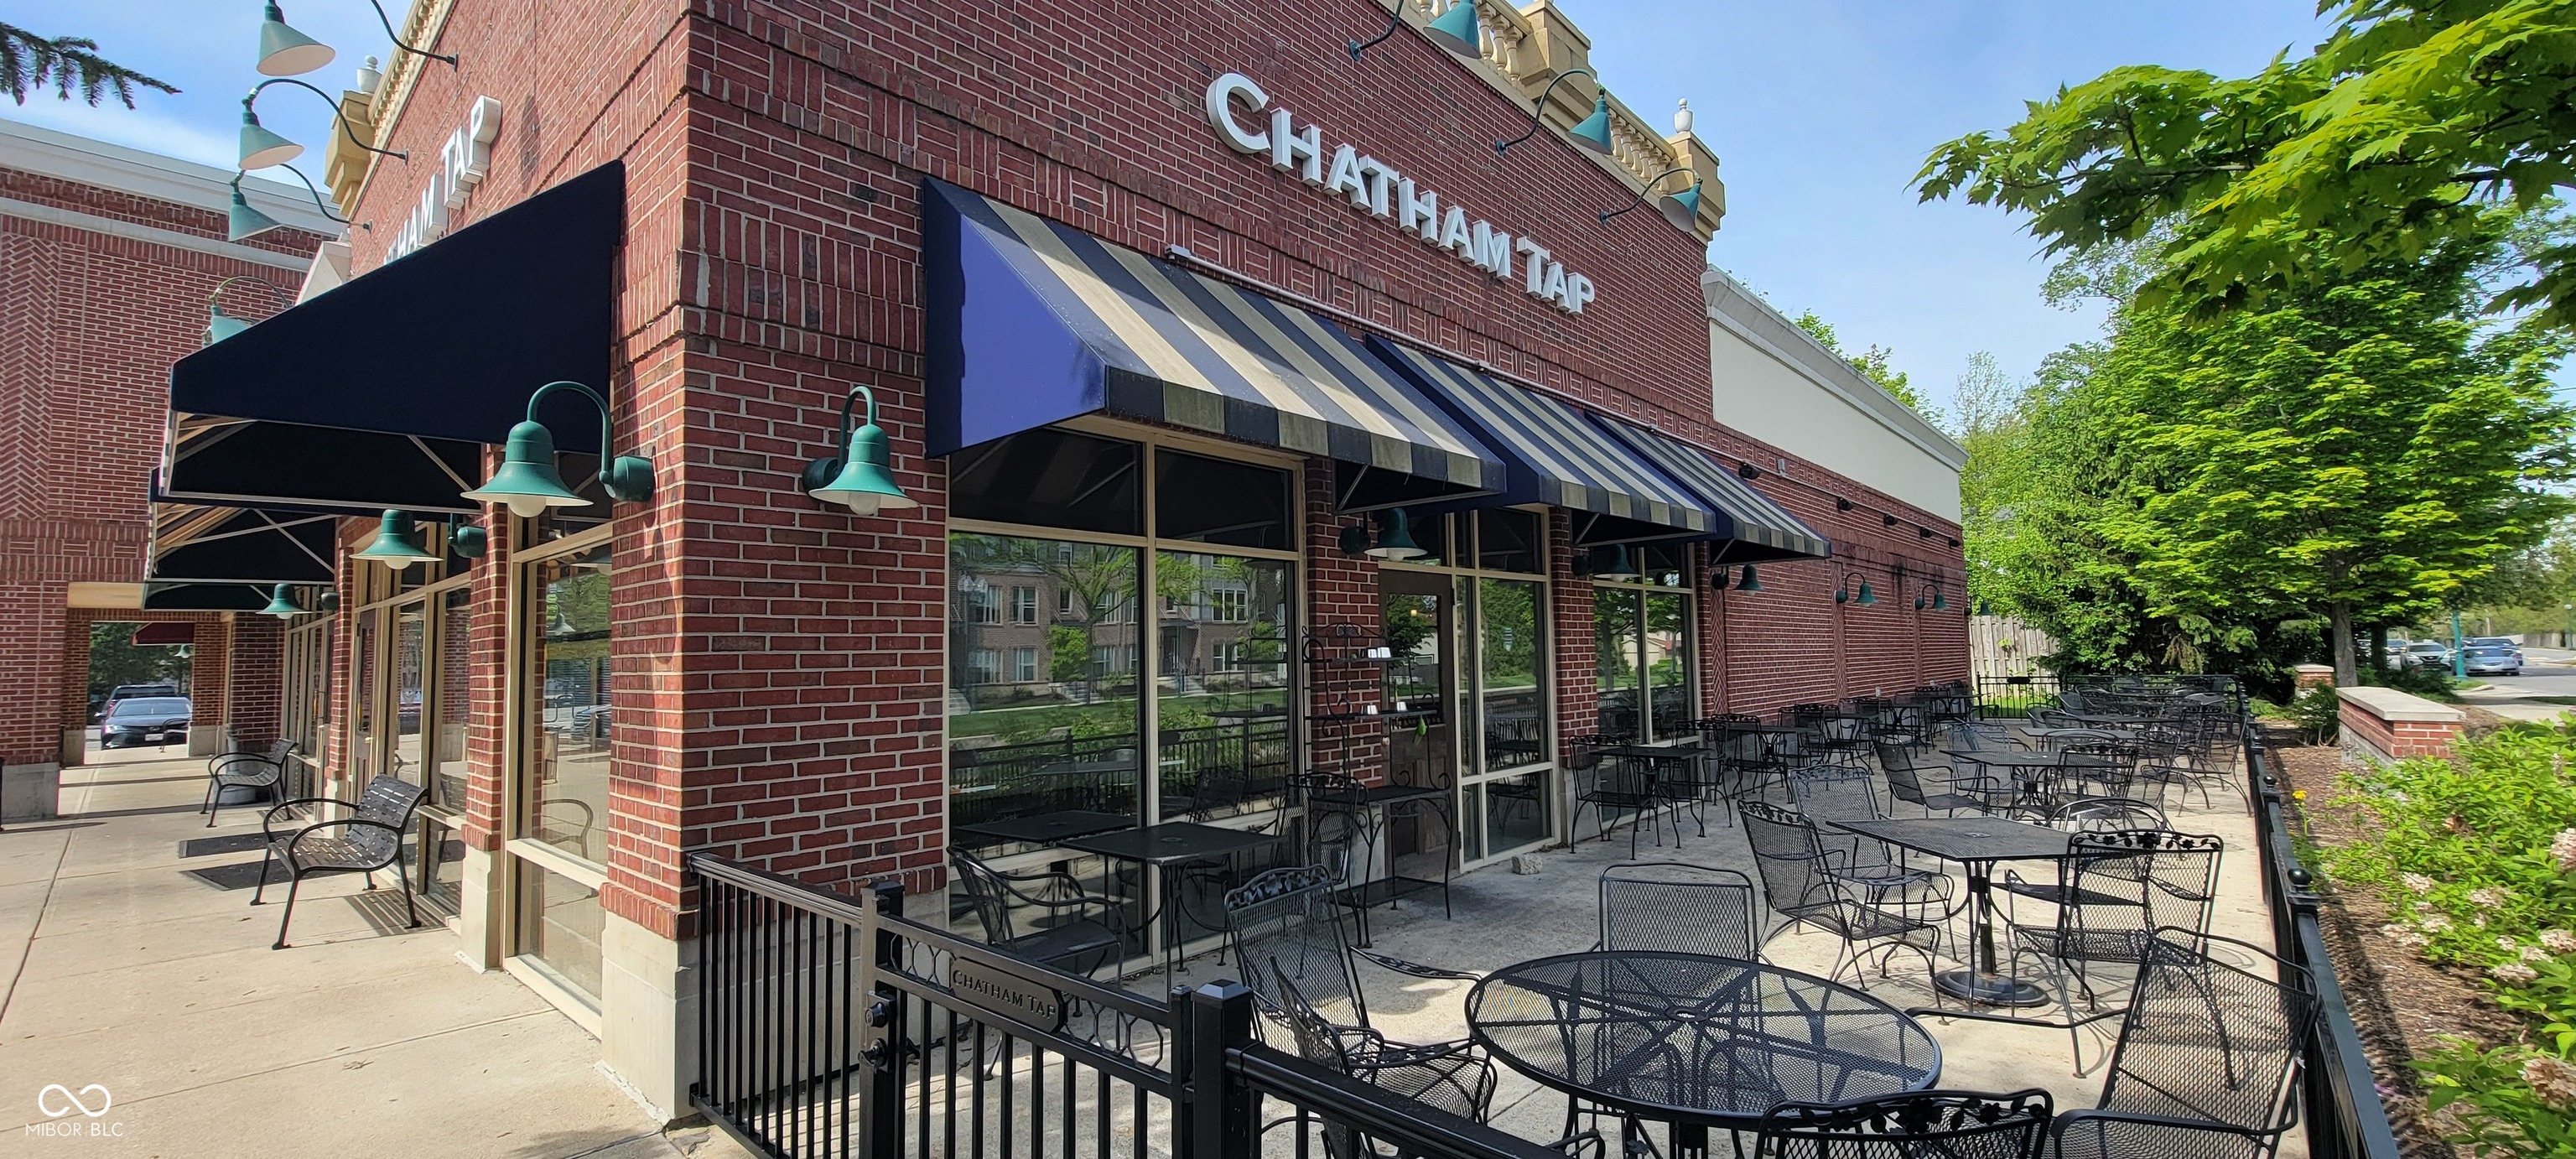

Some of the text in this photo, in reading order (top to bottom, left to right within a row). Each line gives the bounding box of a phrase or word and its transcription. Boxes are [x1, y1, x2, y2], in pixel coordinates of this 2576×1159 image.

[441, 95, 502, 210] TAP
[1206, 72, 1595, 315] CHATHAM TAP
[953, 969, 1056, 1019] CHATHAM TAP
